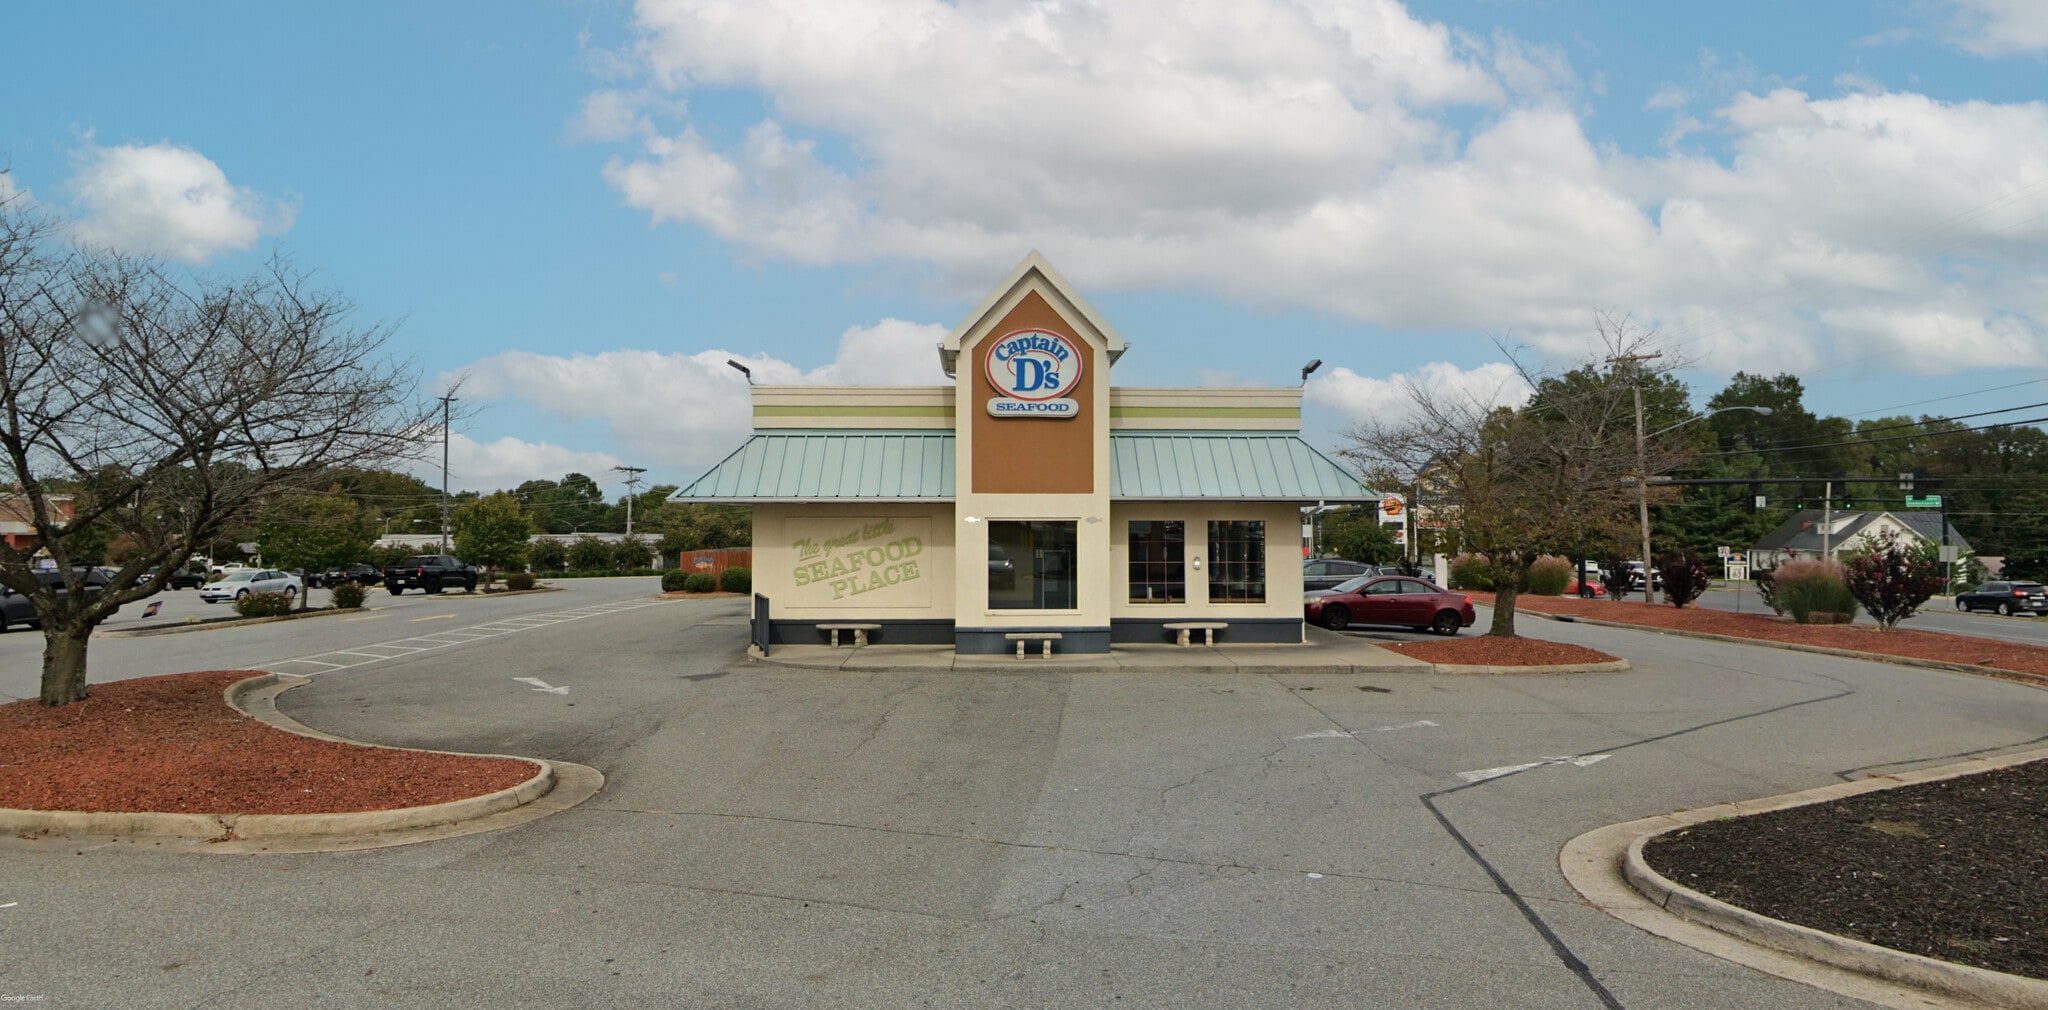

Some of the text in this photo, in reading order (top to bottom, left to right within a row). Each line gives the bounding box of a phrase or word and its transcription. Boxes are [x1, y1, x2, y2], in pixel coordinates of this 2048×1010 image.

[995, 333, 1069, 362] Captain
[1012, 358, 1060, 391] D's
[996, 402, 1070, 412] SEAFOOD
[792, 516, 895, 558] The great little
[793, 536, 923, 586] SEAFOOD
[829, 560, 920, 600] PLACE
